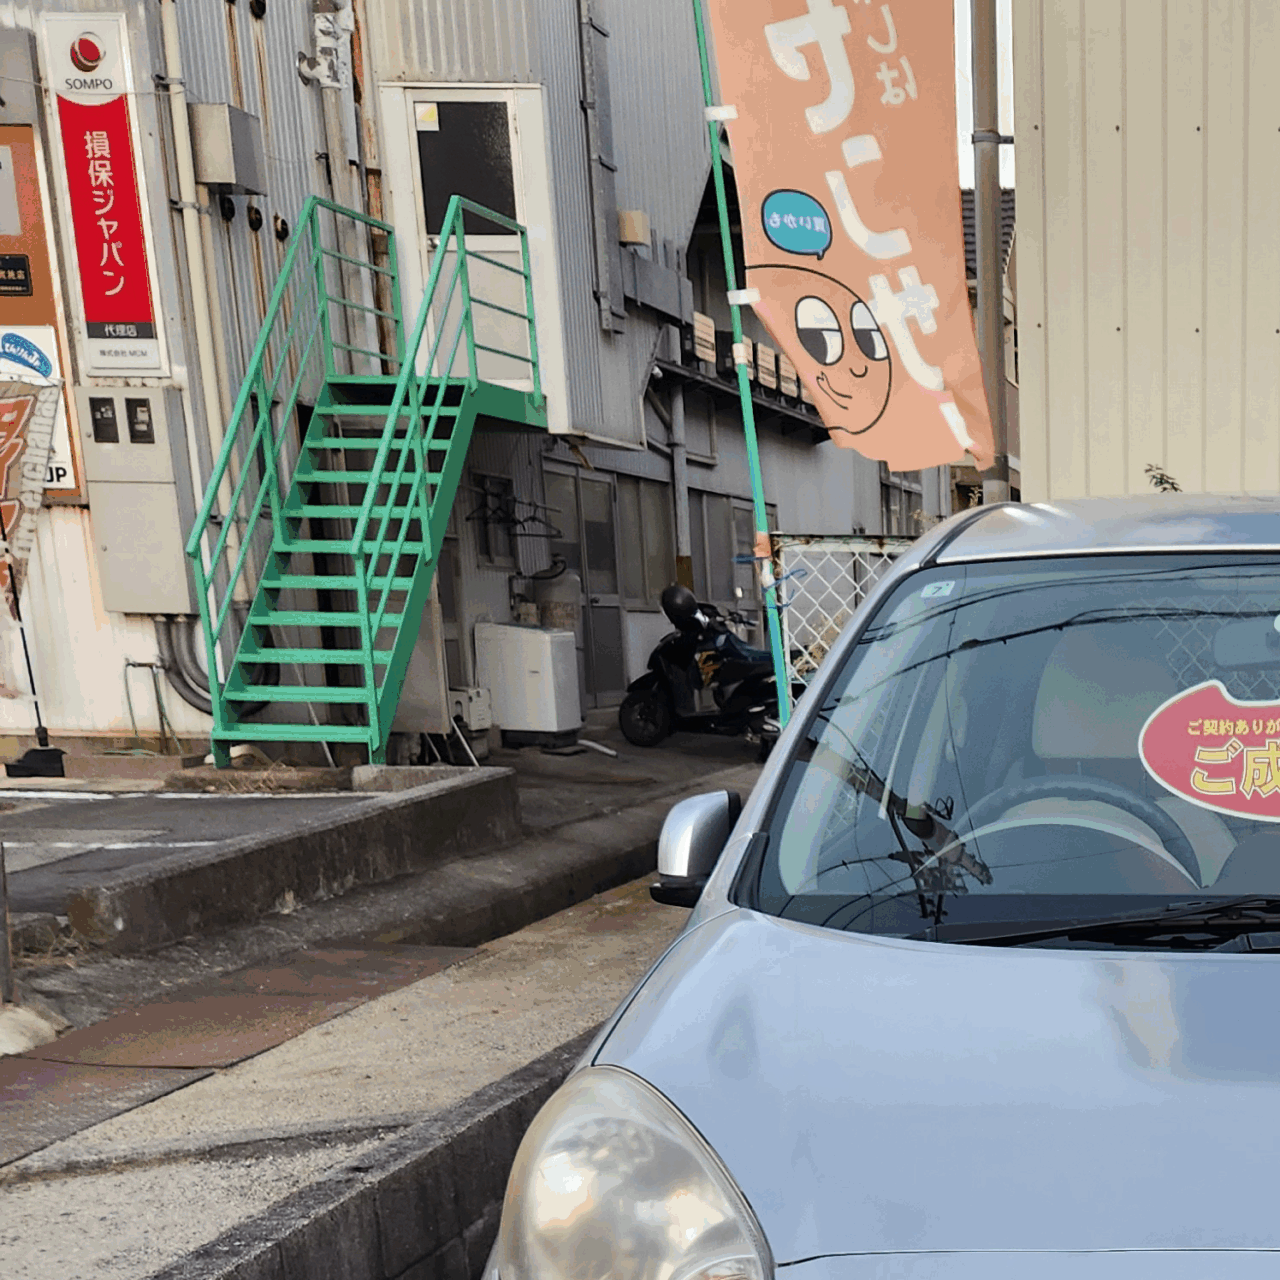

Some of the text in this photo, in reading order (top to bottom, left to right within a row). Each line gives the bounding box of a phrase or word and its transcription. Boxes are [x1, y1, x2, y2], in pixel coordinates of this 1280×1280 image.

[65, 78, 113, 90] SOMPO
[84, 131, 125, 295] 損保ジャパン
[104, 324, 137, 337] 代理店
